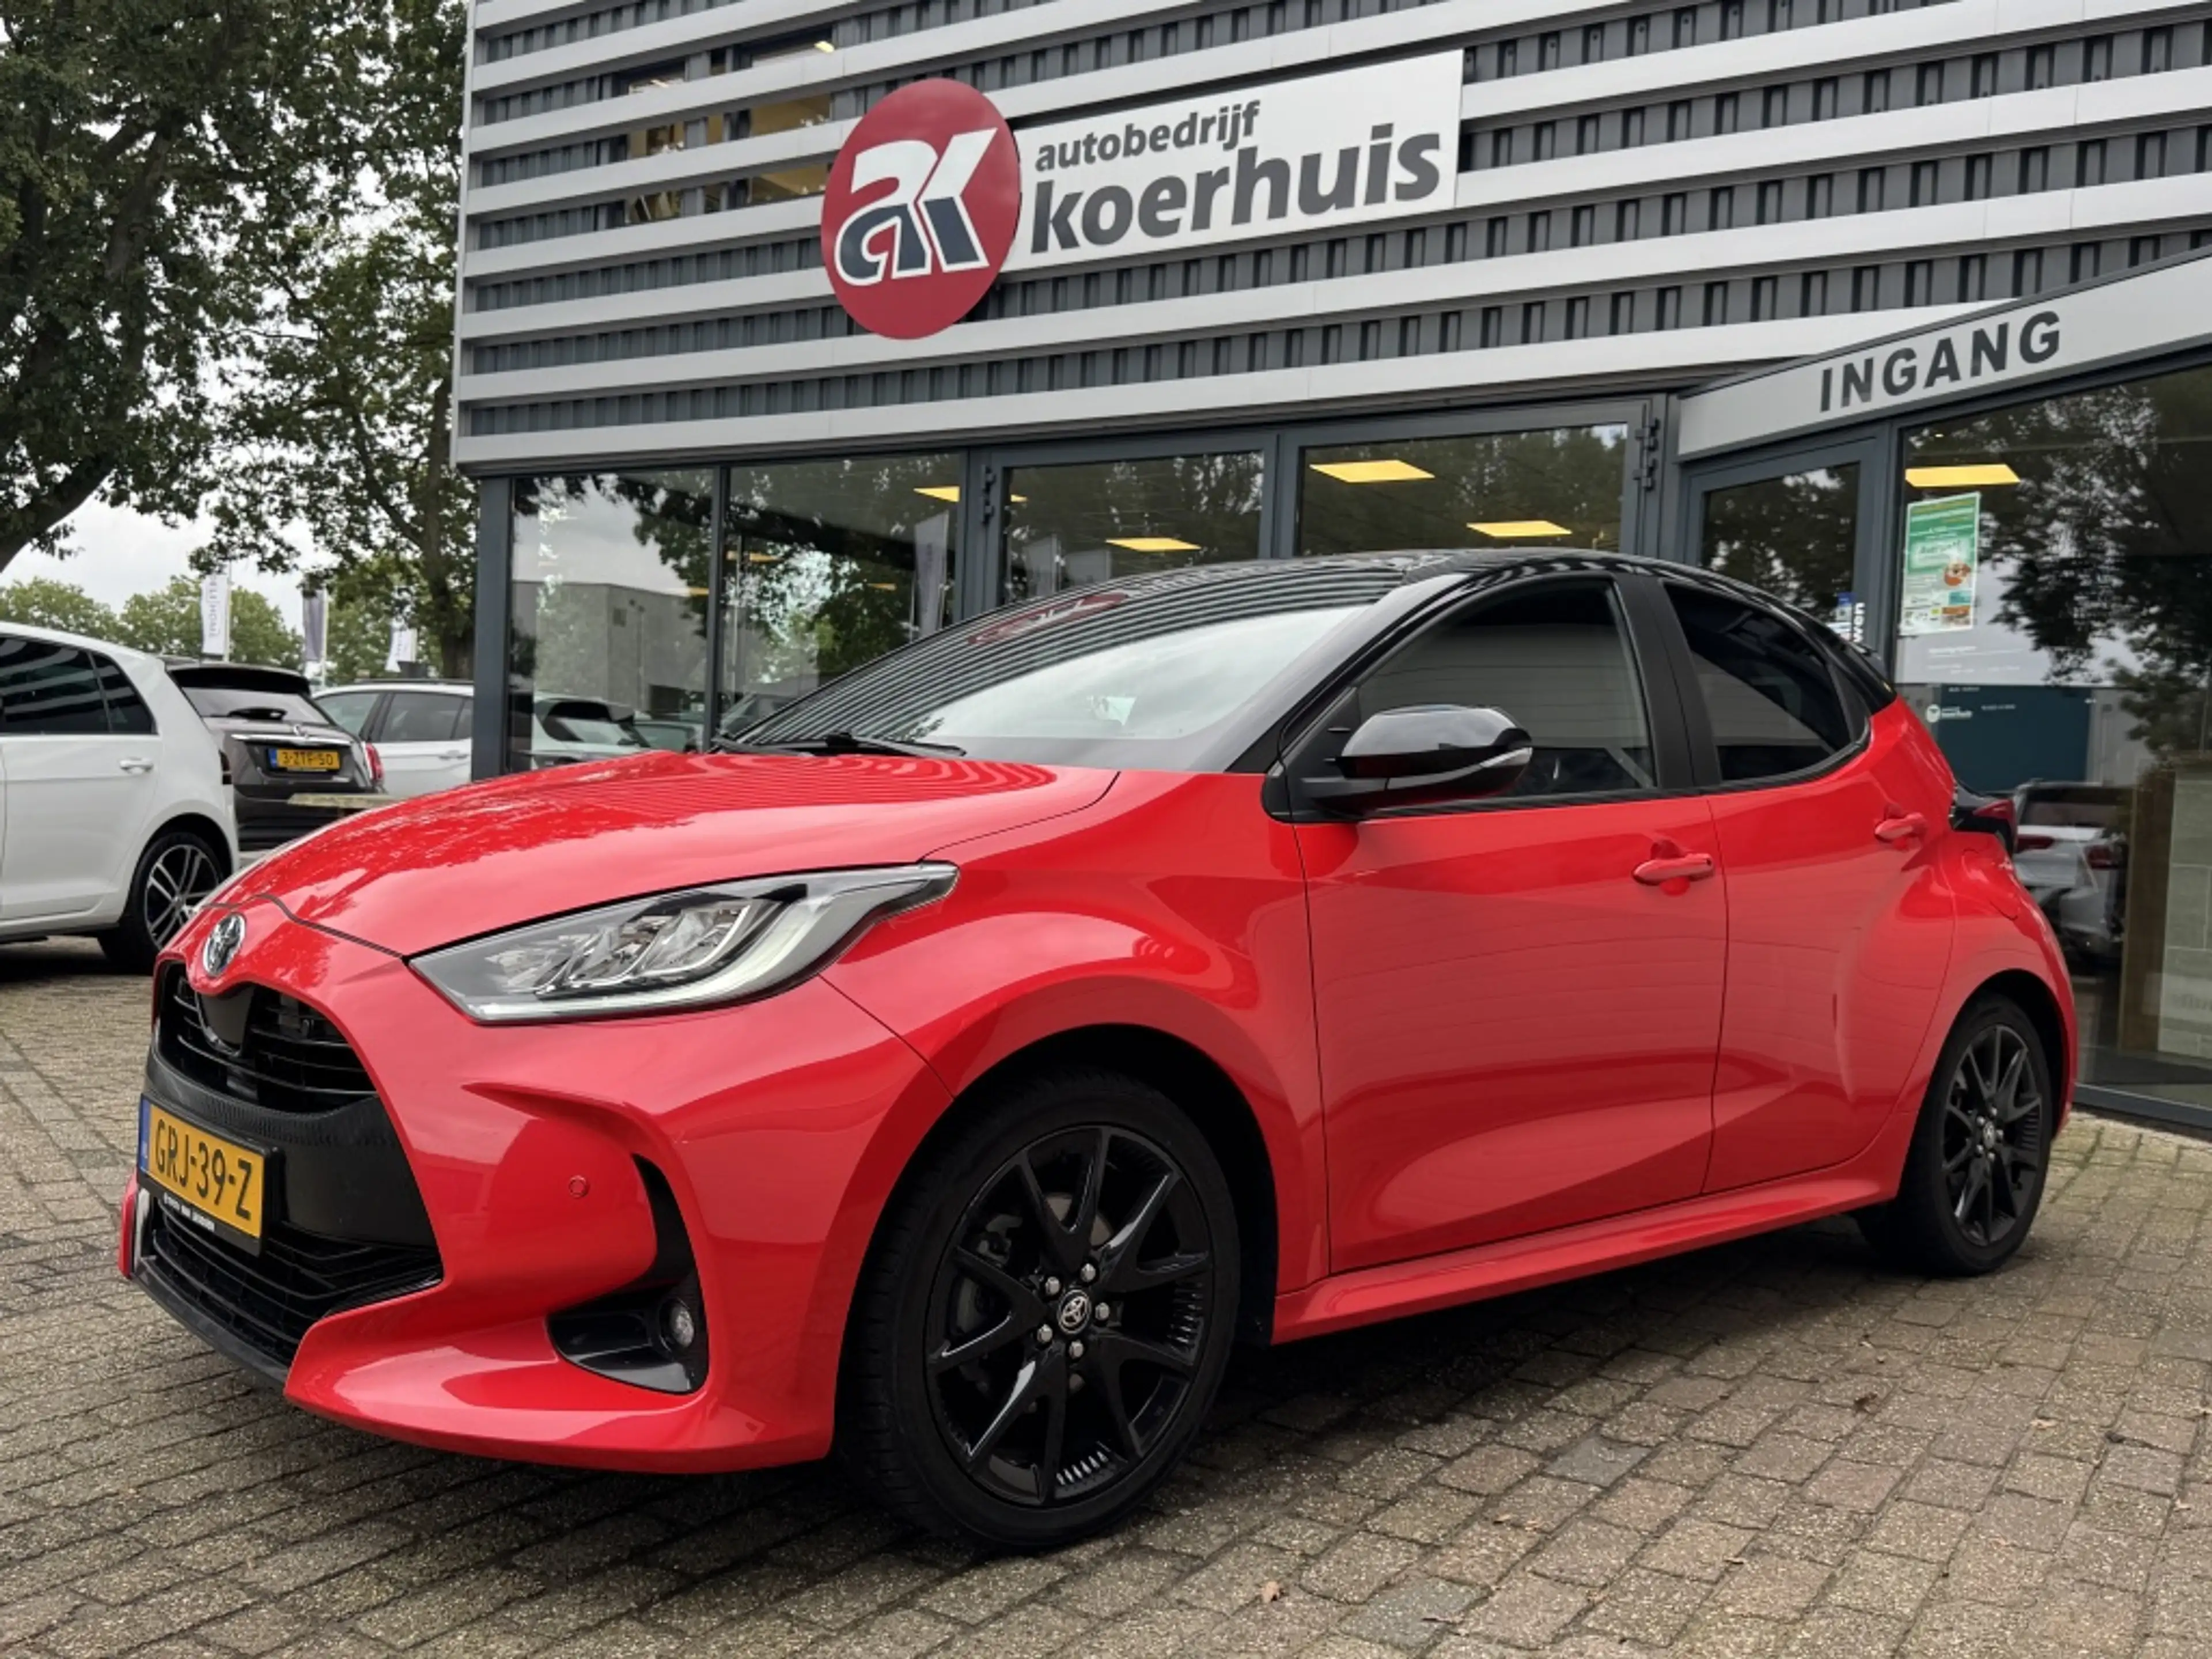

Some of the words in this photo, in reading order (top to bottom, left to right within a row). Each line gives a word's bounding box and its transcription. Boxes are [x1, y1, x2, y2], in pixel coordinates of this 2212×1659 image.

[1035, 100, 1261, 172] autobedrijf
[1031, 122, 1441, 254] koerhuis
[1820, 310, 2060, 412] INGANG
[156, 1119, 252, 1221] GRJ-39-Z
